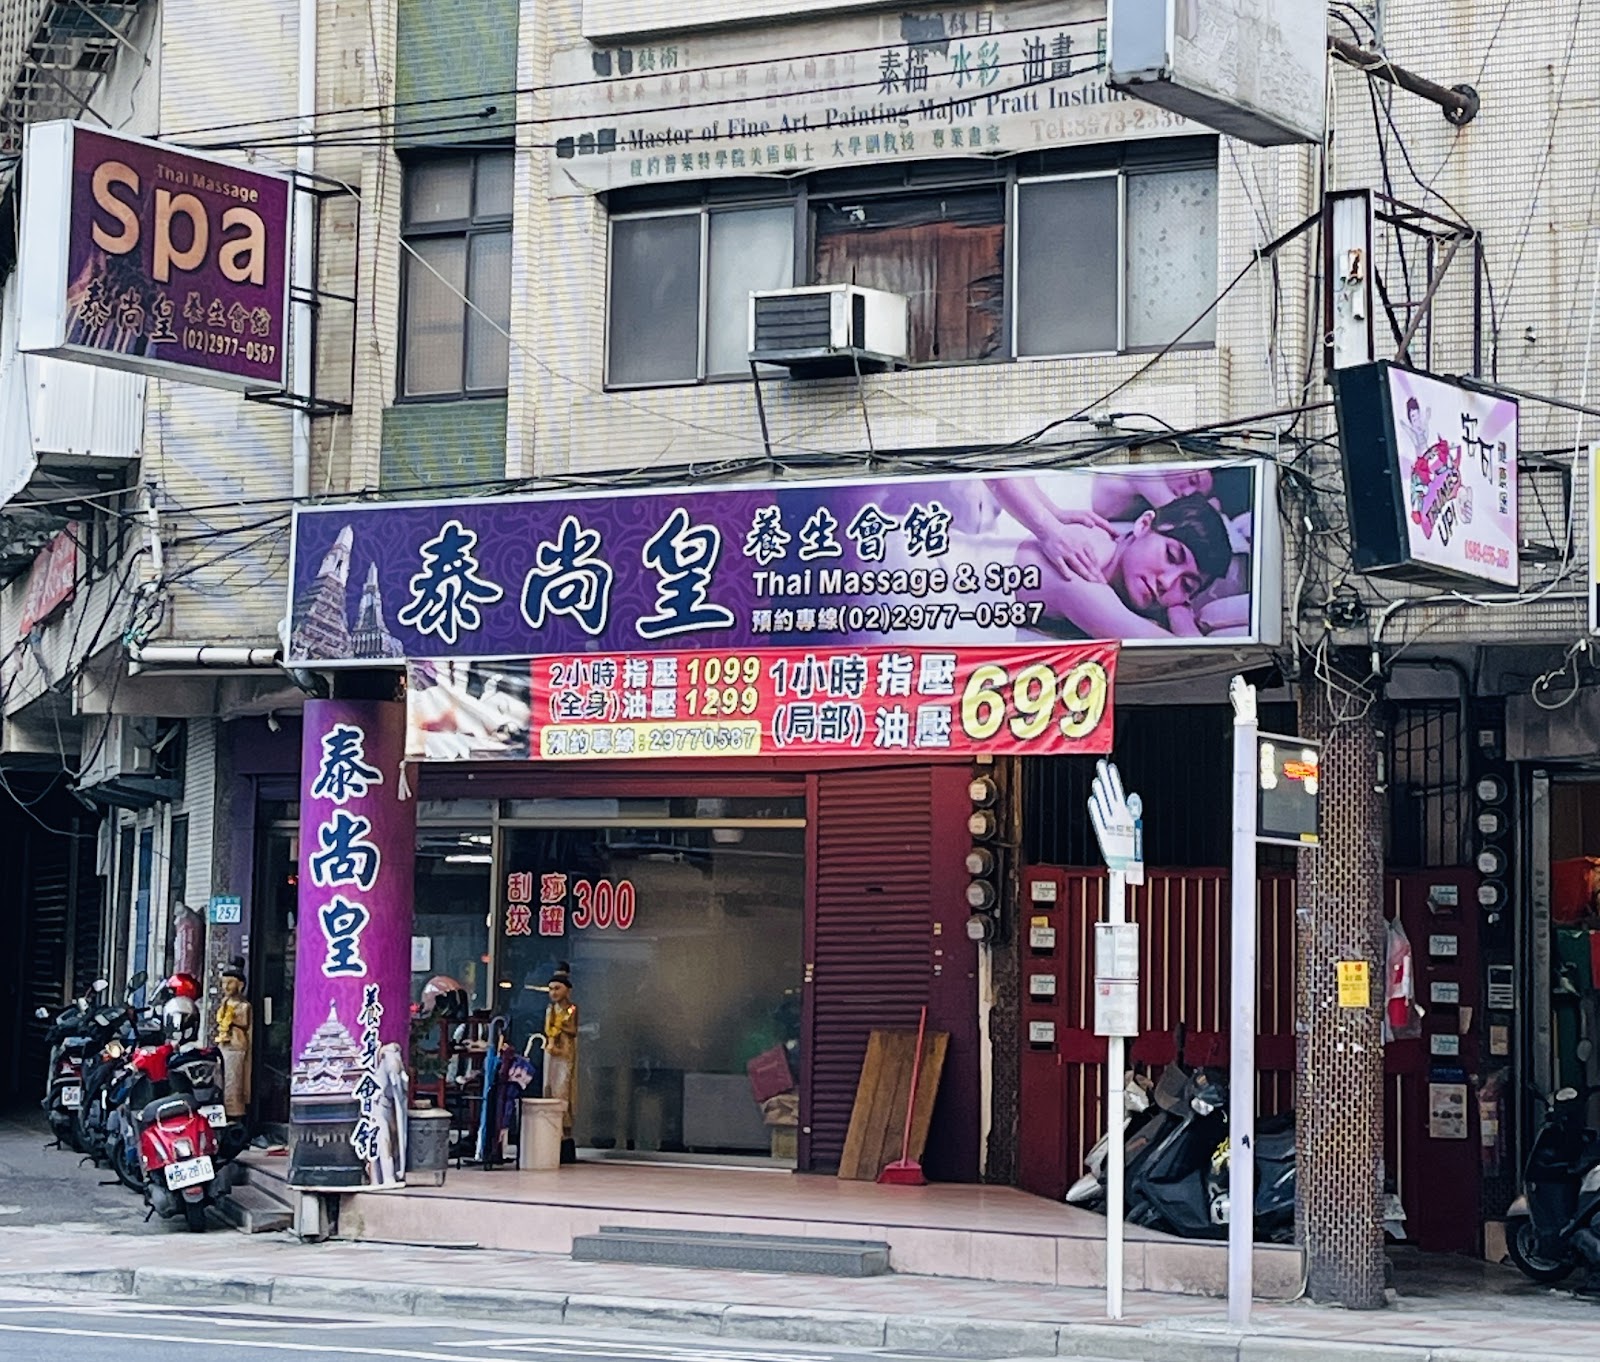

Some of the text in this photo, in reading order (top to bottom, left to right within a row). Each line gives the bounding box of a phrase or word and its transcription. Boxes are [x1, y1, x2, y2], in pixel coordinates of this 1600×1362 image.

[877, 48, 930, 95] 素描
[950, 40, 1001, 88] 水彩
[1022, 32, 1075, 84] 油畫
[702, 120, 719, 142] of
[728, 117, 770, 139] Fine
[825, 103, 910, 129] Painting
[918, 96, 977, 124] Major
[986, 89, 1040, 116] Pratt
[157, 163, 259, 203] Thai Massage
[91, 160, 267, 286] Spa
[79, 278, 178, 343] 泰尚皇
[183, 290, 273, 337] 養生會館
[183, 325, 276, 364] (02)2977-0587
[744, 501, 954, 566] 養生會館
[398, 507, 736, 645] 泰尚皇
[752, 562, 1042, 598] Thai Massage & Spa
[549, 656, 762, 690] 2小時 指壓 1099
[769, 653, 1109, 741] 1小時 指壓 699
[549, 687, 761, 724] (全身) 油壓 1299
[772, 702, 953, 749] (局部) 油壓
[310, 722, 384, 979] 泰尚皇
[507, 871, 567, 904] 刮痧
[571, 879, 636, 930] 300
[218, 906, 239, 920] 257
[505, 904, 566, 937] 拔罐
[351, 983, 385, 1161] 養身會館
